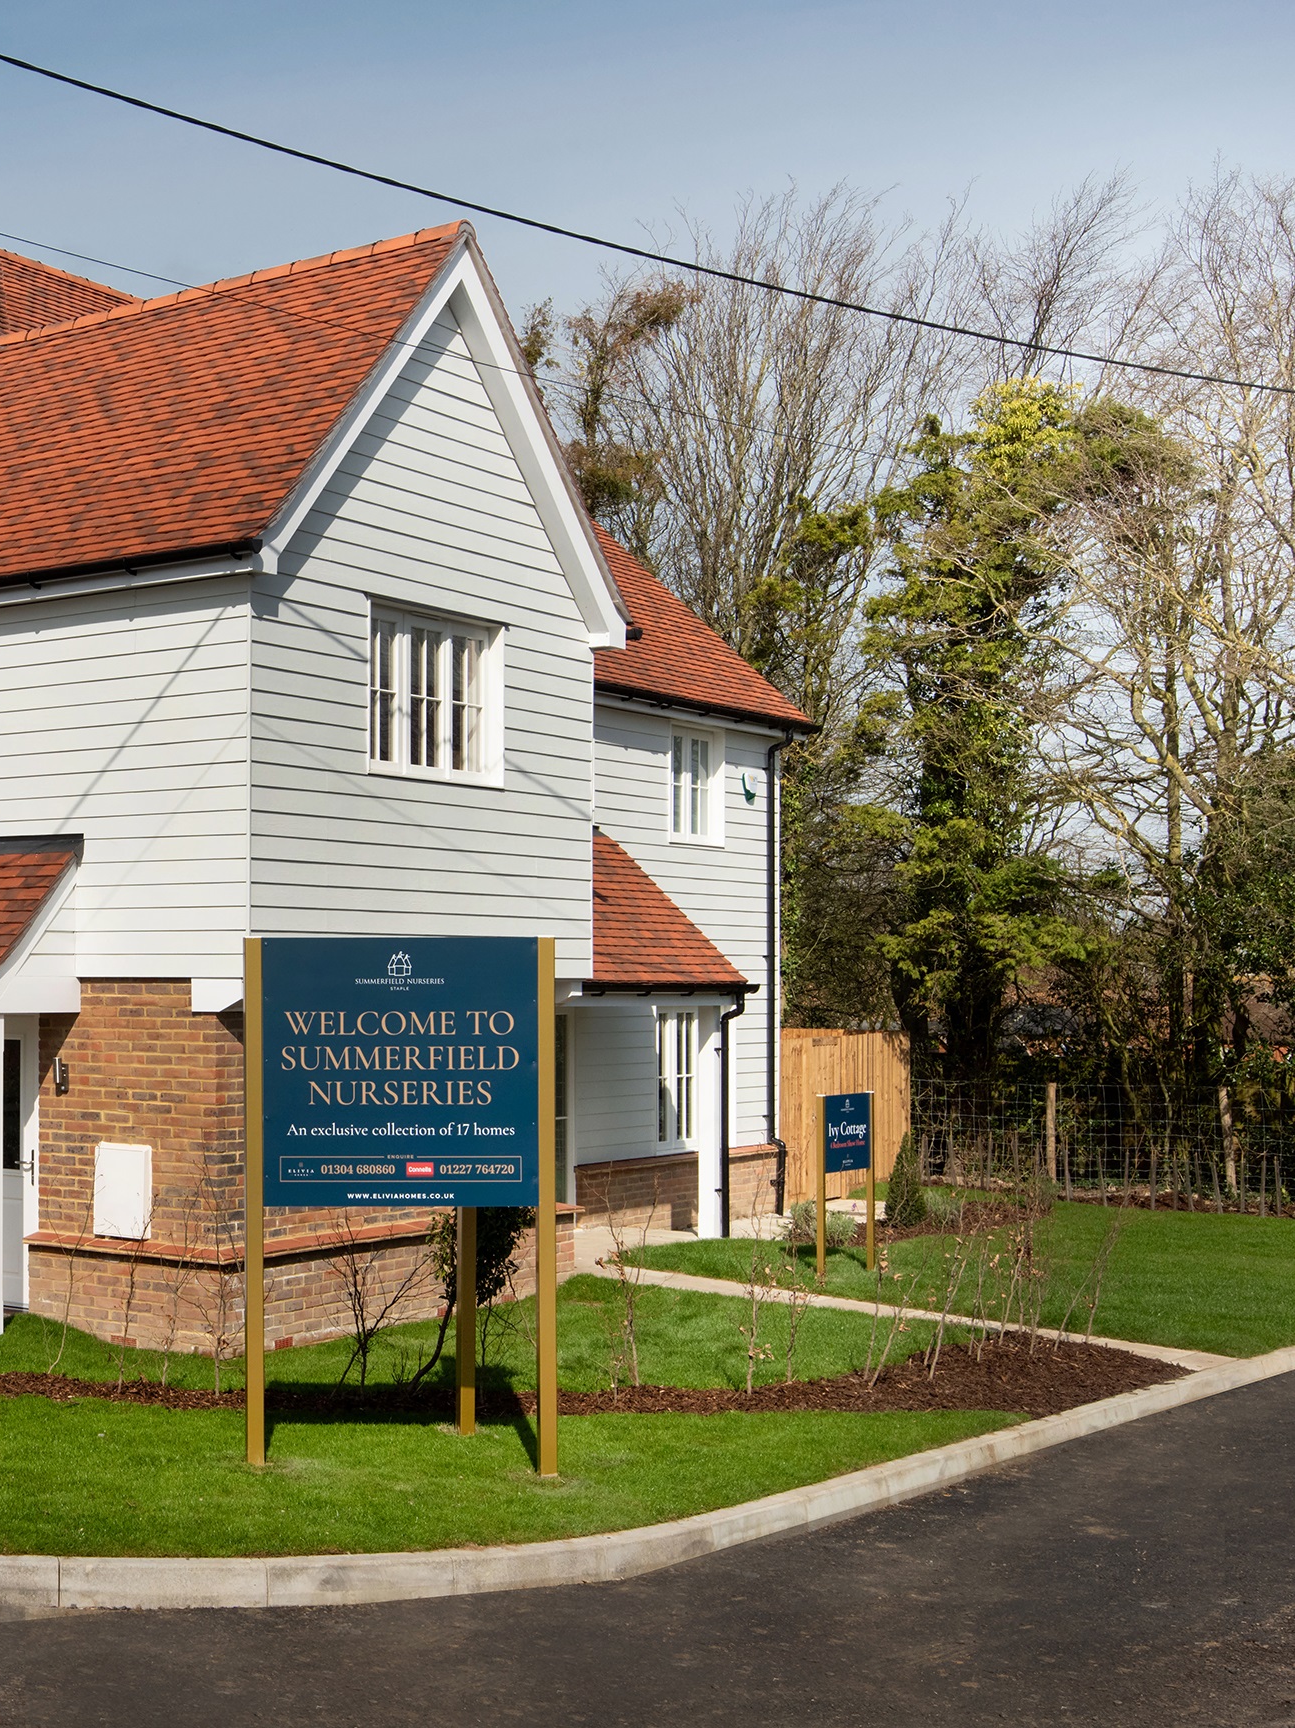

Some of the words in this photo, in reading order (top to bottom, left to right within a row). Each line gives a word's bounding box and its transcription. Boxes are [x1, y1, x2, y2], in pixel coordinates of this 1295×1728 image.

[355, 977, 405, 985] SUMMERFIELD
[407, 977, 445, 985] NURSERIES
[284, 1010, 457, 1036] WELCOME
[466, 1010, 515, 1036] TO
[281, 1045, 520, 1071] SUMMERFIELD
[308, 1080, 492, 1106] NURSERIES
[286, 1123, 307, 1137] An
[310, 1122, 369, 1137] exclusive
[372, 1122, 436, 1137] collection
[439, 1121, 455, 1137] of
[457, 1123, 470, 1137] 17
[473, 1121, 516, 1137] homes
[828, 1123, 839, 1142] Ivy
[840, 1121, 867, 1139] Cottage
[320, 1164, 353, 1175] 01304
[356, 1164, 396, 1175] 680860
[439, 1163, 473, 1175] 01227
[475, 1163, 515, 1175] 764720
[346, 1192, 455, 1200] WWW.ELIVIAHOMES.CO.UK
